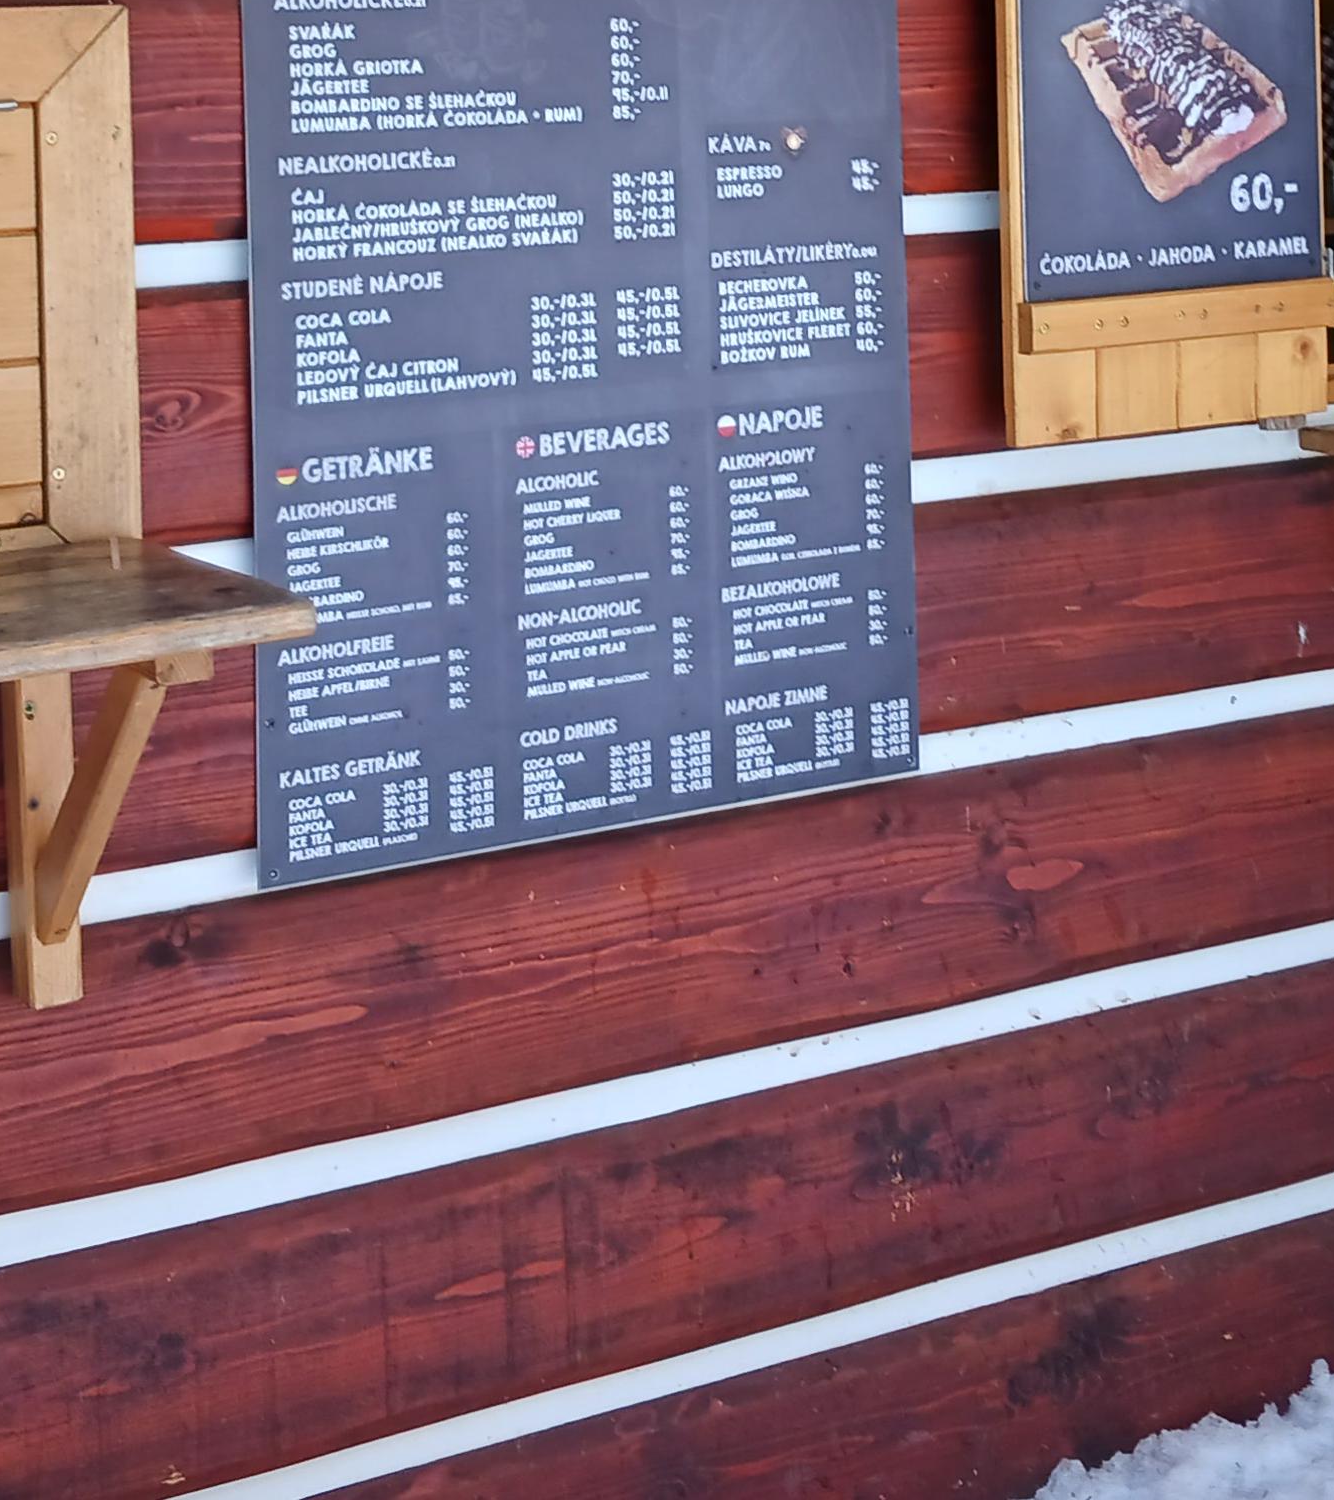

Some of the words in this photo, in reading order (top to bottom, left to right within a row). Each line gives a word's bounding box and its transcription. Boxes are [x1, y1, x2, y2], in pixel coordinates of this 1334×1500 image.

[288, 21, 356, 41] SVAŘÁK
[289, 43, 337, 60] GROG
[289, 58, 348, 78] HORKÁ
[353, 58, 425, 76] GRIOTKA
[291, 96, 400, 116] BOMBARDINO
[405, 94, 424, 110] SE
[291, 115, 372, 134] LUMUMBA
[545, 106, 584, 124] RUM)
[708, 132, 758, 155] KÁVA
[278, 147, 433, 176] NEALKOHOLICKÉ
[717, 164, 783, 182] ESPRESSO
[291, 187, 324, 206] ČAJ
[717, 182, 765, 200] LUNGO
[1229, 172, 1299, 214] 60,-
[291, 204, 350, 225] HORKÁ
[447, 199, 466, 215] SE
[466, 214, 510, 232] GROG
[515, 210, 584, 229] (NEALKO)
[292, 242, 348, 262] HORKÝ
[353, 236, 437, 259] FRANCOUZ
[441, 232, 507, 253] (NEALKO
[1039, 249, 1131, 276] ČOKOLÁDA
[1148, 244, 1216, 270] JAHODA
[1233, 236, 1309, 260] KARAMEL
[281, 274, 364, 300] STUDENÉ
[369, 270, 444, 295] NÁPOJE
[719, 275, 808, 296] BECHEROVKA
[295, 312, 344, 331] COCA
[348, 308, 392, 326] COLA
[720, 310, 791, 330] SLIVOVICE
[808, 322, 851, 340] FLERET
[296, 331, 349, 349] FANTA
[296, 348, 361, 368] KOFOLA
[720, 345, 777, 365] BOŽKOV
[780, 343, 812, 360] RUM
[296, 366, 360, 387] LEDOVÝ
[365, 361, 398, 380] ČAJ
[402, 357, 459, 376] CITRON
[297, 385, 359, 405] PILSNER
[364, 380, 430, 399] URQUELL
[738, 404, 824, 437] NAPOJE
[539, 421, 671, 458] BEVERAGES
[301, 446, 434, 484] GETRÄNKE
[515, 469, 600, 495] ALCOHOLIC
[276, 493, 398, 524] ALKOHOLISCHE
[517, 598, 642, 631] NON-ALCOHOLIC
[277, 633, 396, 668] ALKOHOLFREIE
[724, 691, 781, 717] NAPOJE
[784, 684, 828, 706] ZIMNE
[519, 727, 560, 748] COLD
[564, 717, 618, 742] DRINKS
[279, 763, 341, 789] KALTES
[344, 749, 422, 779] GETRÄNK
[288, 795, 323, 812] COCA
[325, 789, 357, 806] COLA
